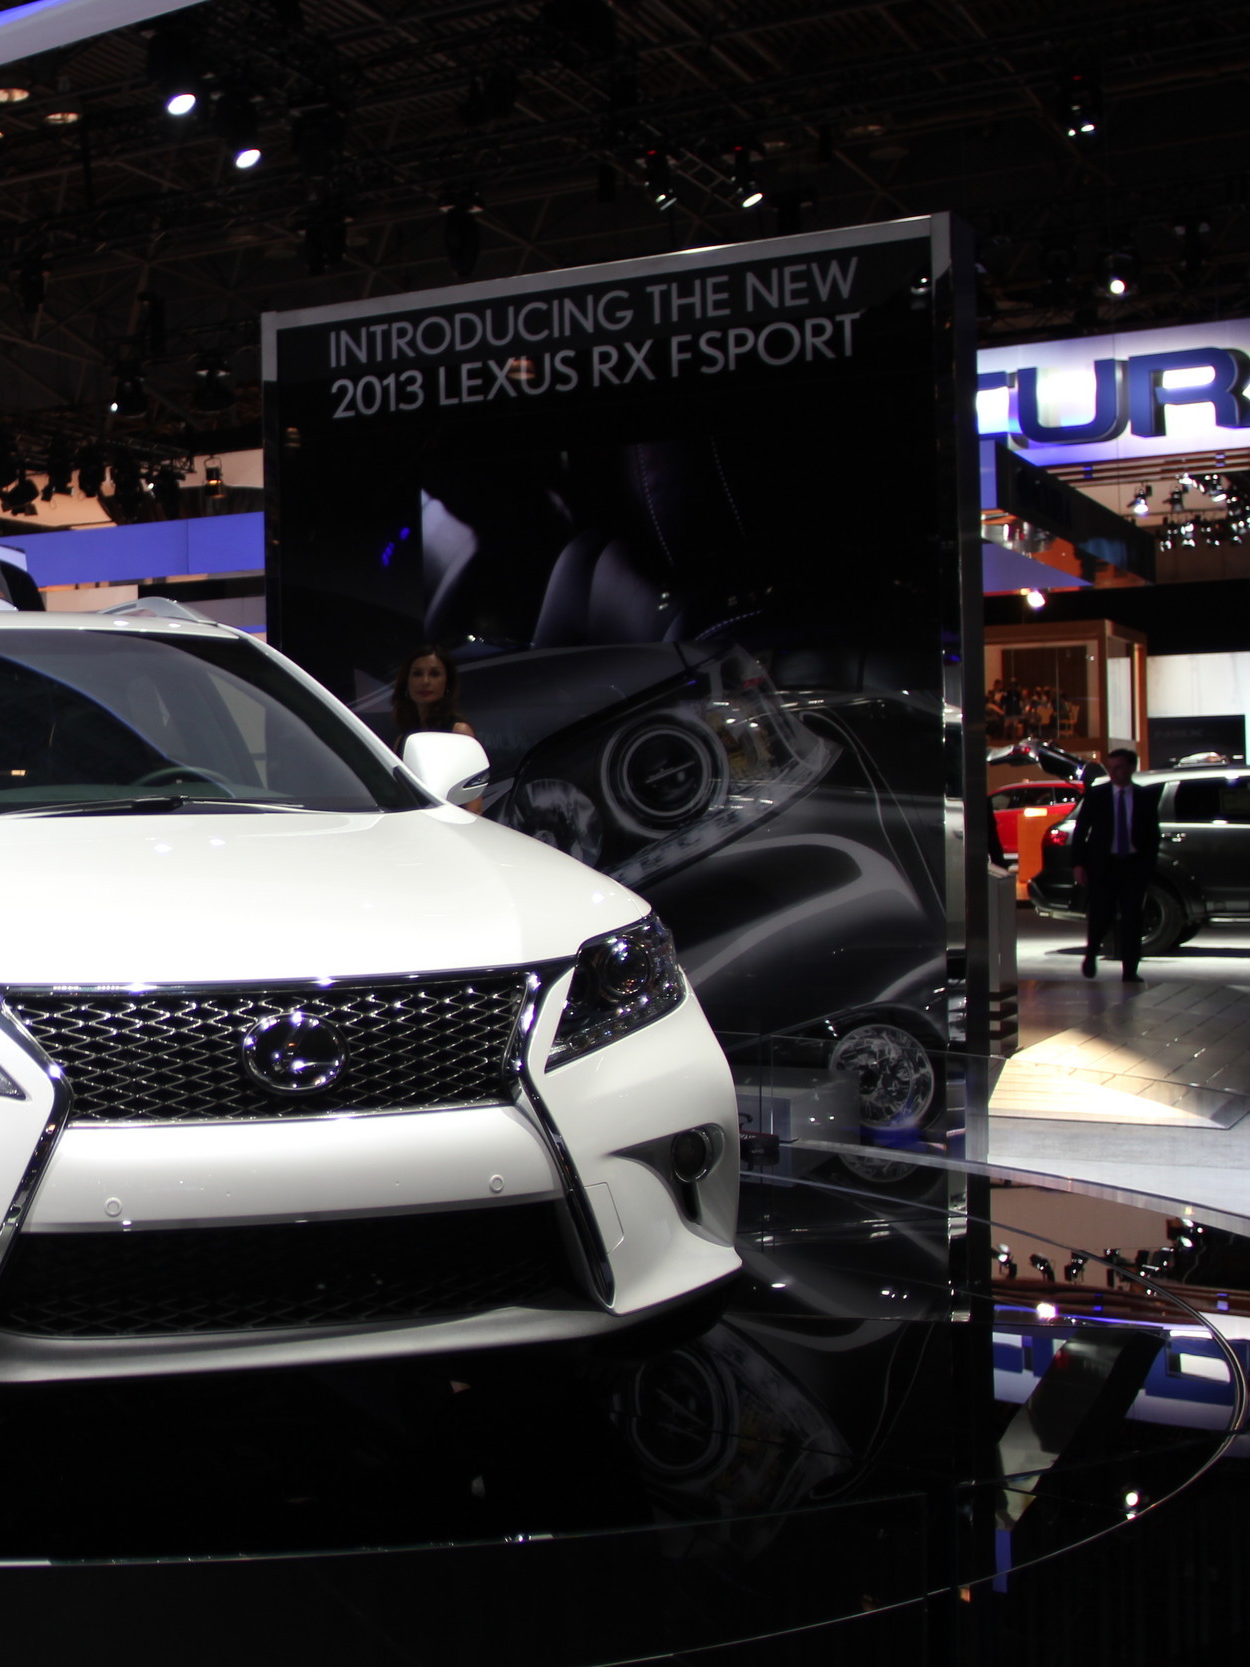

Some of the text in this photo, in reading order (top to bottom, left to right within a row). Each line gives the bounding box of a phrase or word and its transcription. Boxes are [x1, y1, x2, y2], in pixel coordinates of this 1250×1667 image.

[329, 256, 859, 369] INTRODUCING THE NEW
[330, 369, 425, 419] 2013
[438, 349, 579, 406] LEXUS
[592, 338, 657, 388] RX
